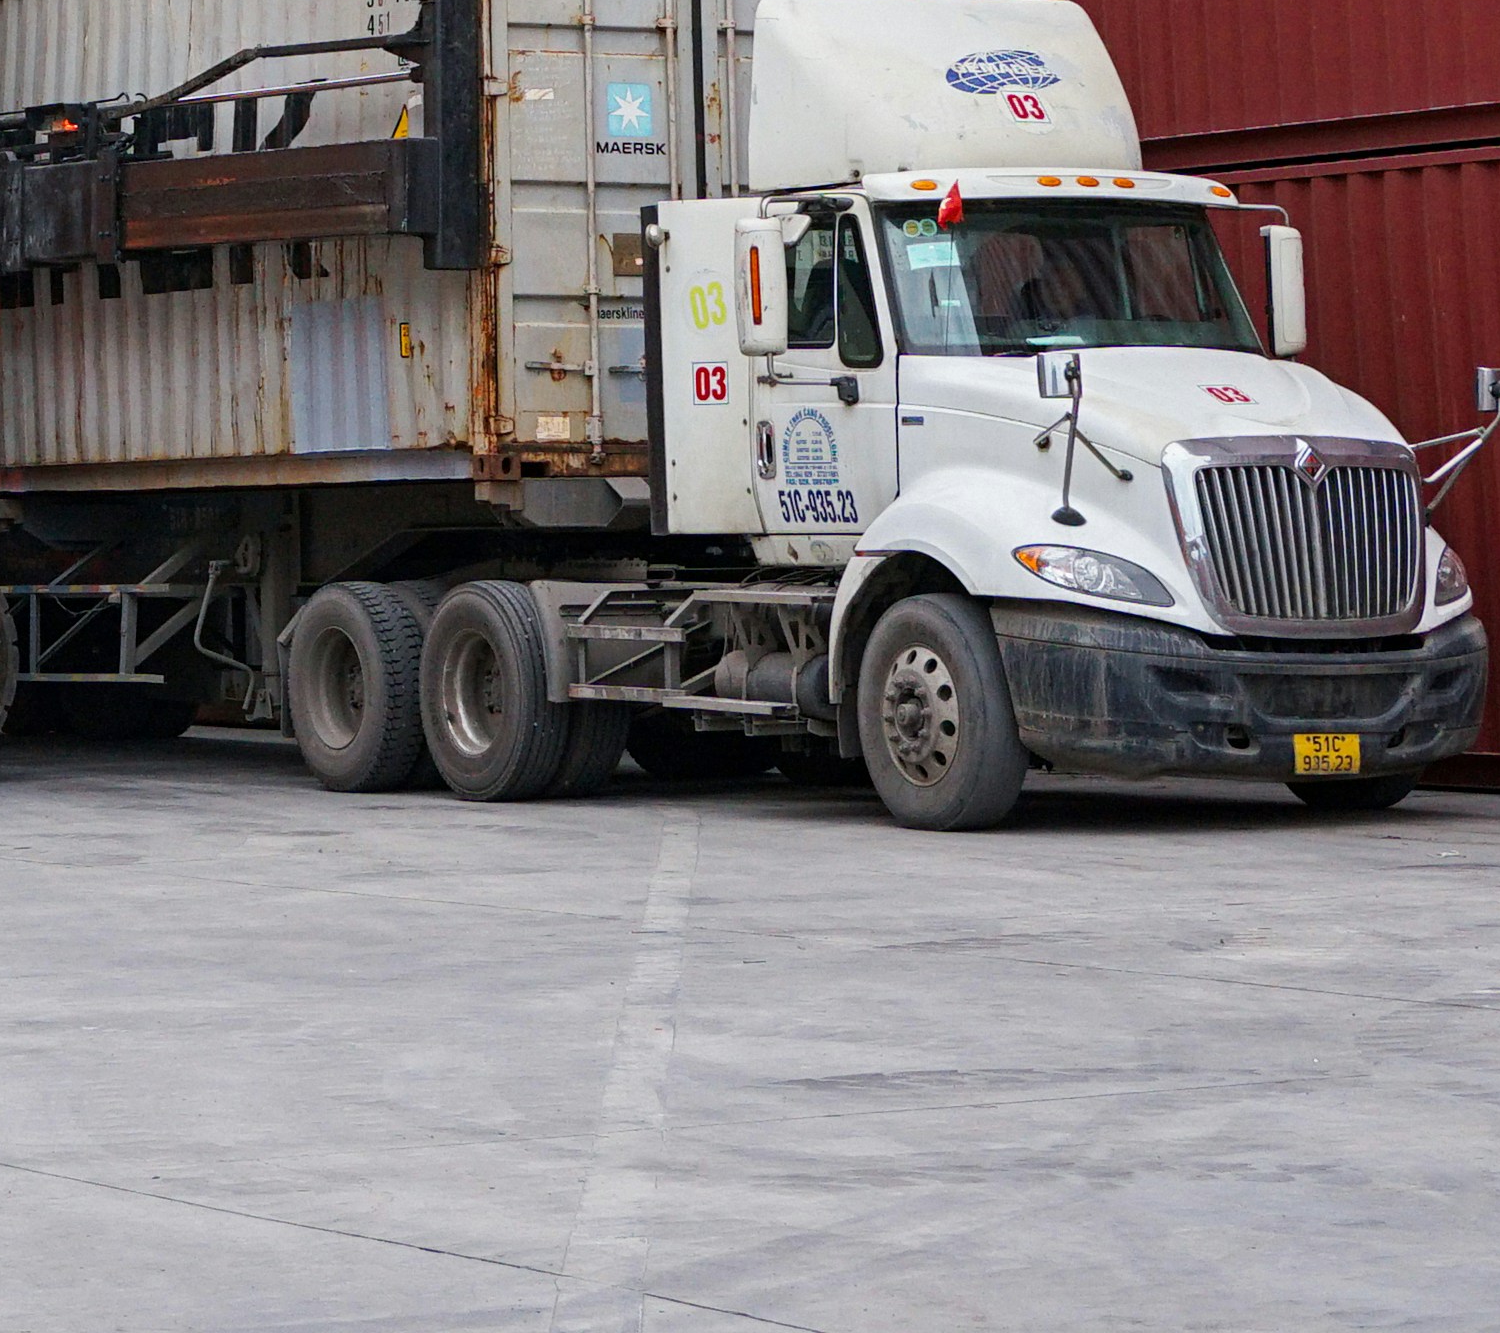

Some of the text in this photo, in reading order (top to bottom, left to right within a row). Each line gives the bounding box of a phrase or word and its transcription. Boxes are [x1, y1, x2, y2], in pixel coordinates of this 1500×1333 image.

[1006, 94, 1045, 120] 03
[596, 140, 667, 155] MAERSK
[690, 281, 727, 330] 03
[695, 366, 727, 401] 03
[1206, 386, 1251, 403] 03
[778, 489, 859, 524] 51C-935.23
[1312, 735, 1341, 753] 51C
[1302, 755, 1353, 772] 935.23
